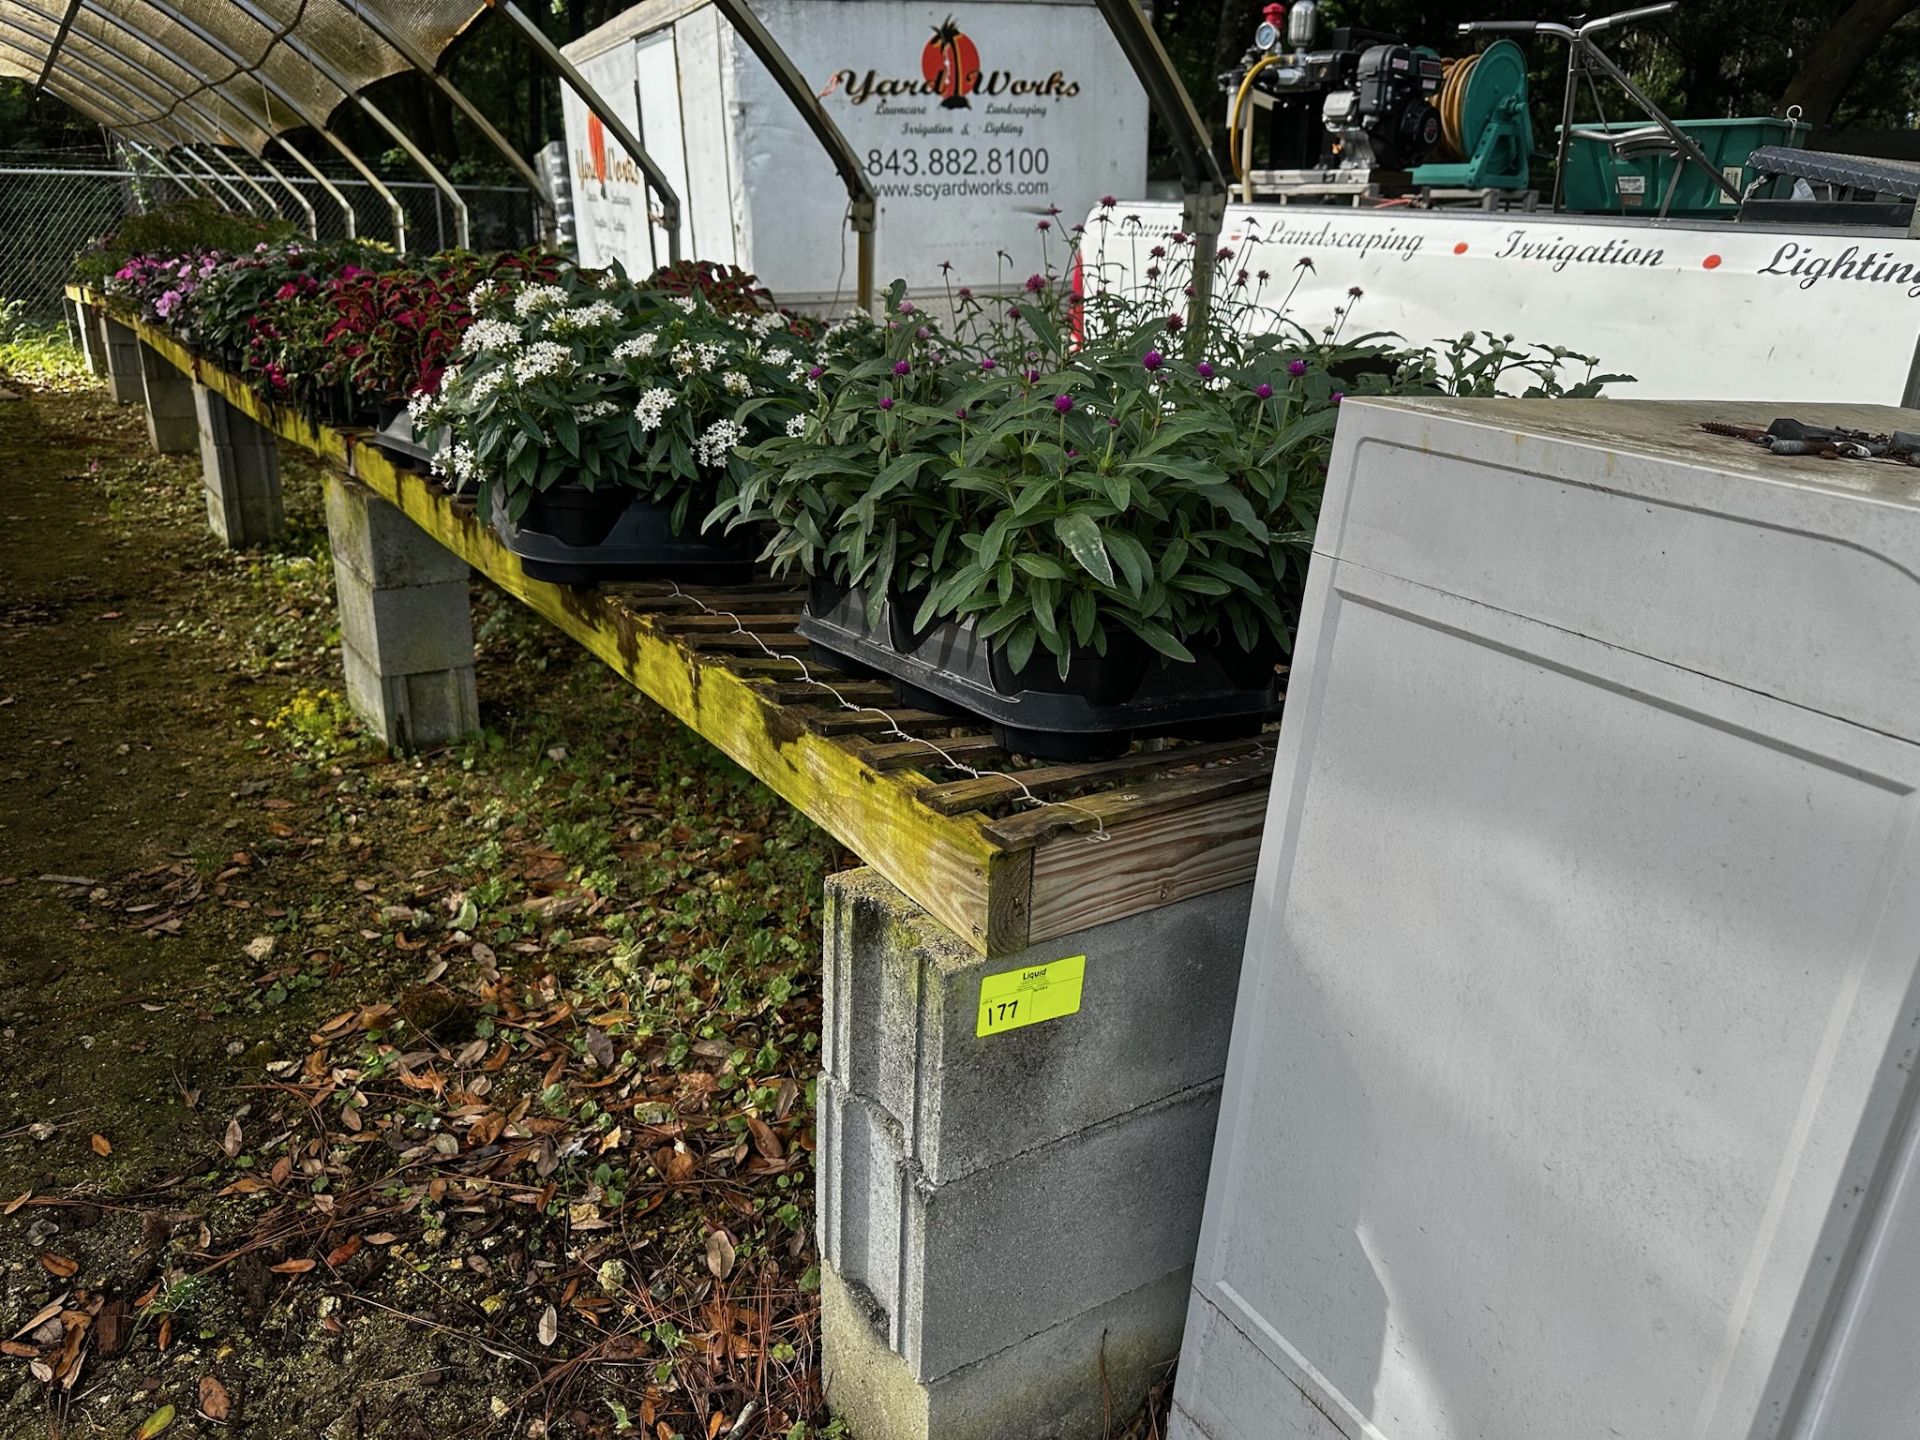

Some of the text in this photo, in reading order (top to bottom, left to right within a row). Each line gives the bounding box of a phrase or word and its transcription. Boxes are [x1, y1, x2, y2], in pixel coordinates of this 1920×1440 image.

[837, 69, 1080, 105] Yard Works
[867, 148, 1049, 176] 843.882.8100
[1261, 219, 1425, 262] Landscaping
[1495, 230, 1665, 273] Irrigation
[988, 999, 1019, 1027] 177
